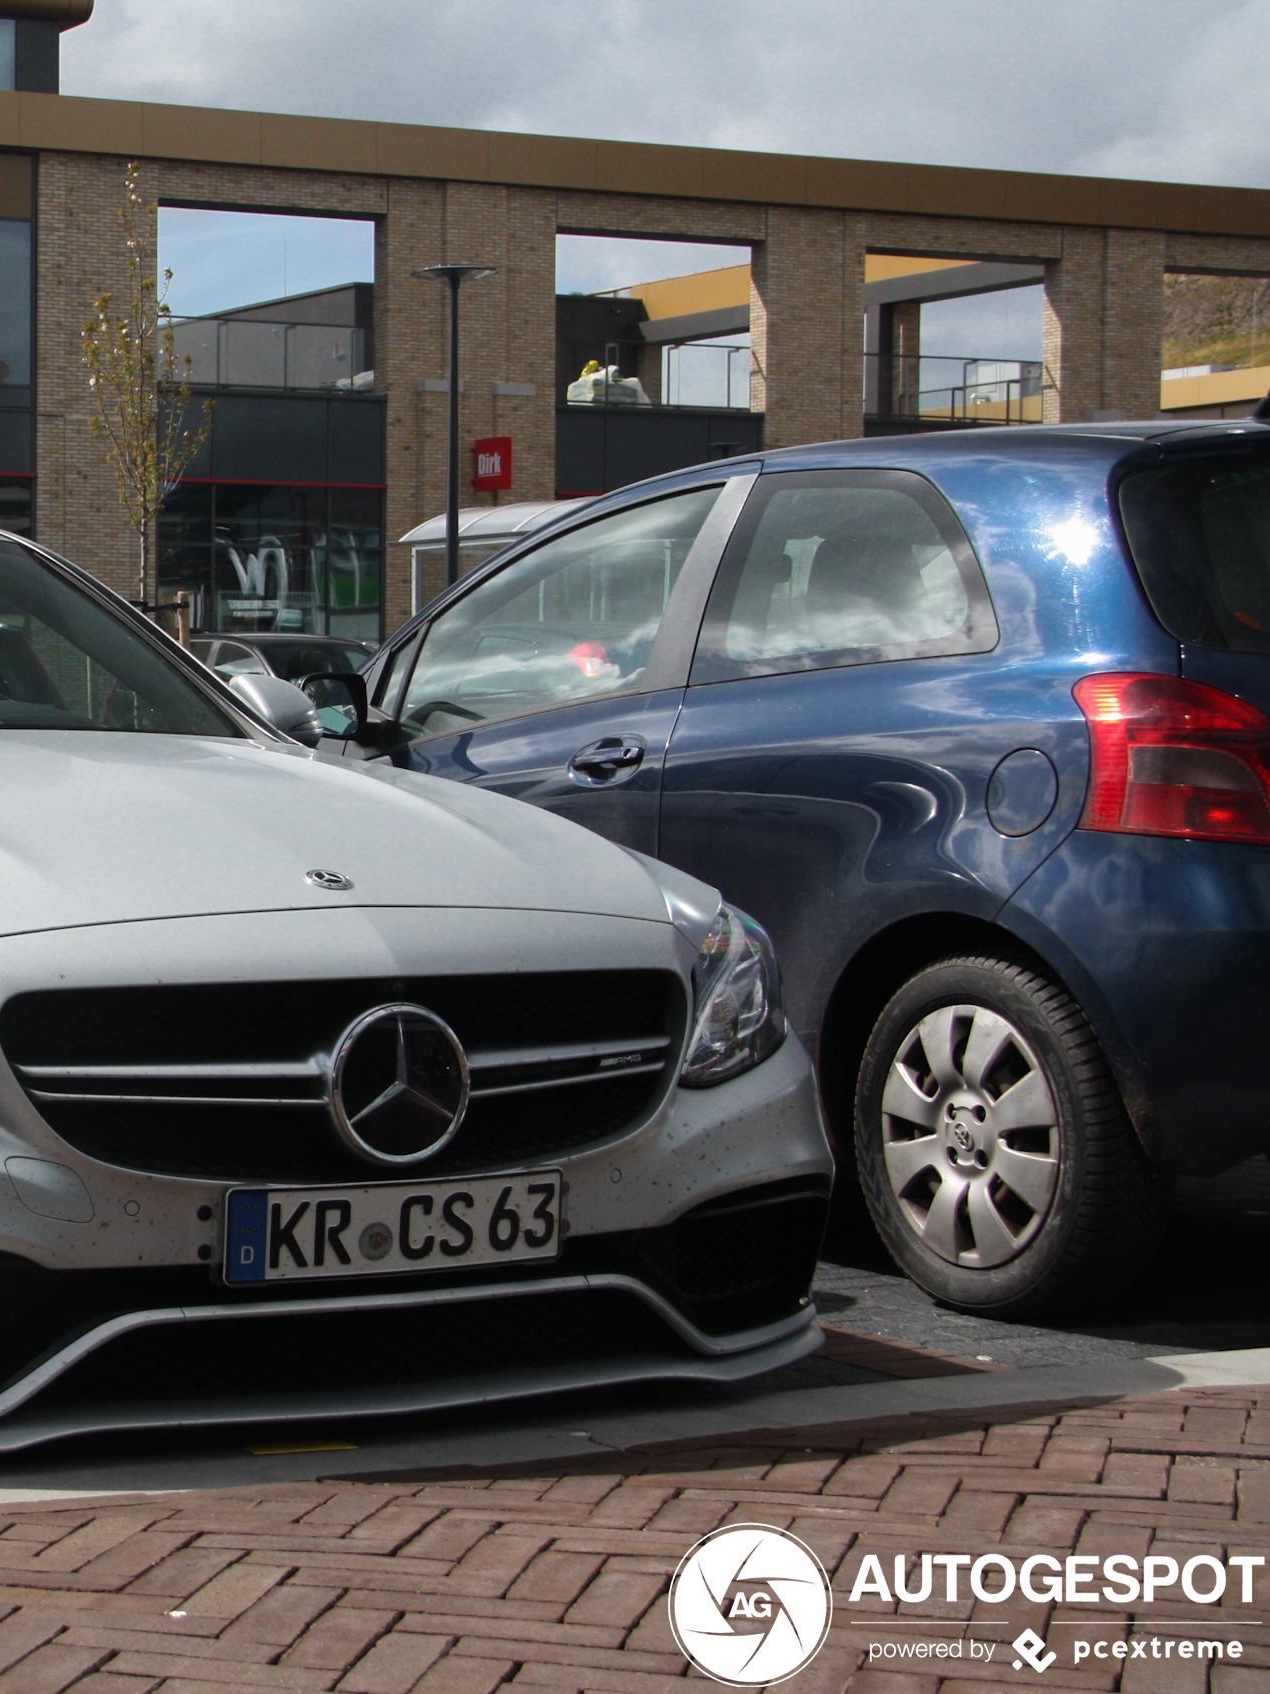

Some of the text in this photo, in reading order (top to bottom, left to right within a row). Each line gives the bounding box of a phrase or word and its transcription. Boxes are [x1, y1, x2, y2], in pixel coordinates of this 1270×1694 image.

[478, 452, 501, 475] Dirk
[240, 1182, 556, 1268] D KR CS 63
